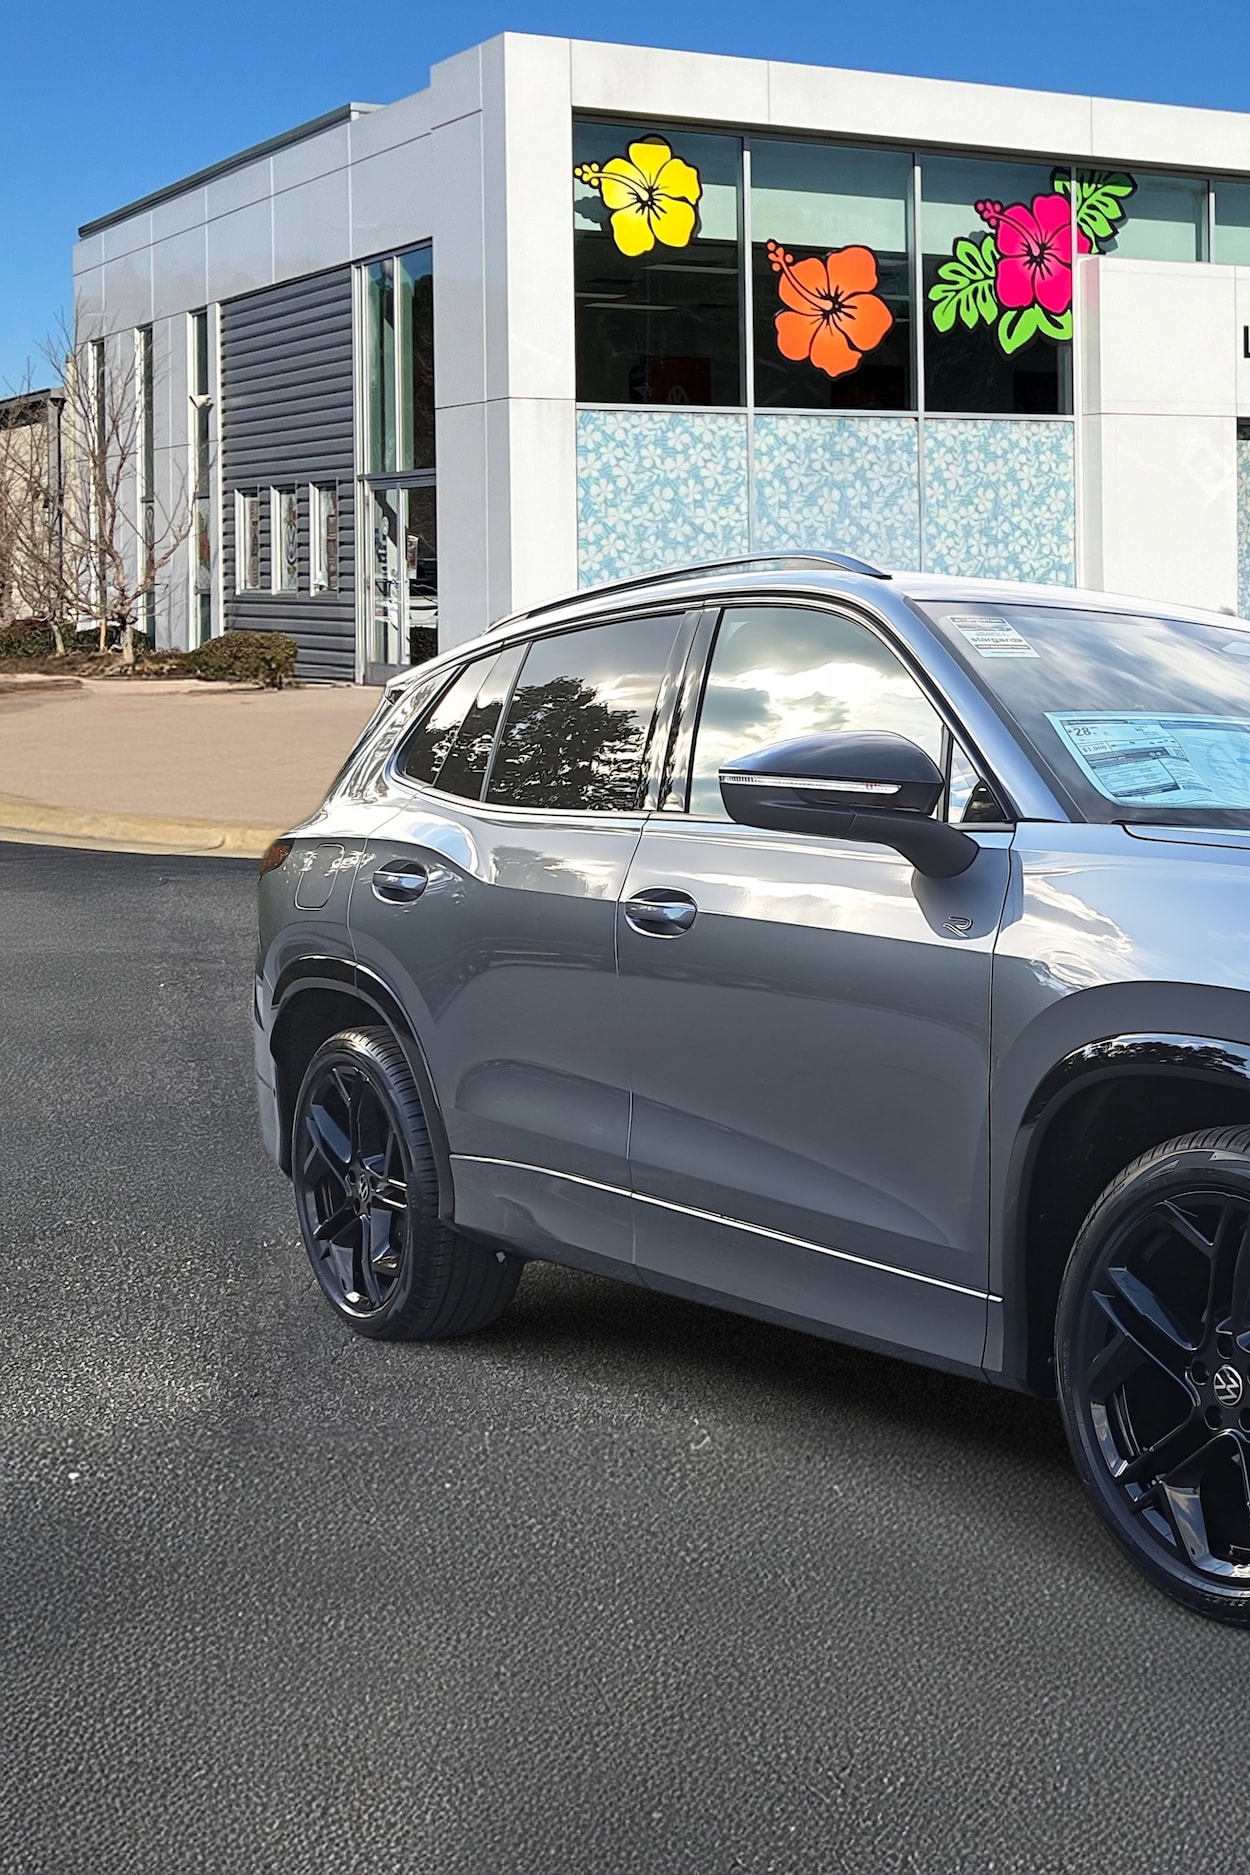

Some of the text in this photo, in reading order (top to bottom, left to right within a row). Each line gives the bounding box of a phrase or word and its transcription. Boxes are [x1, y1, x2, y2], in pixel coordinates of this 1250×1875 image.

[1073, 727, 1091, 736] 28
[942, 916, 973, 937] R
[1213, 1365, 1243, 1407] VW
